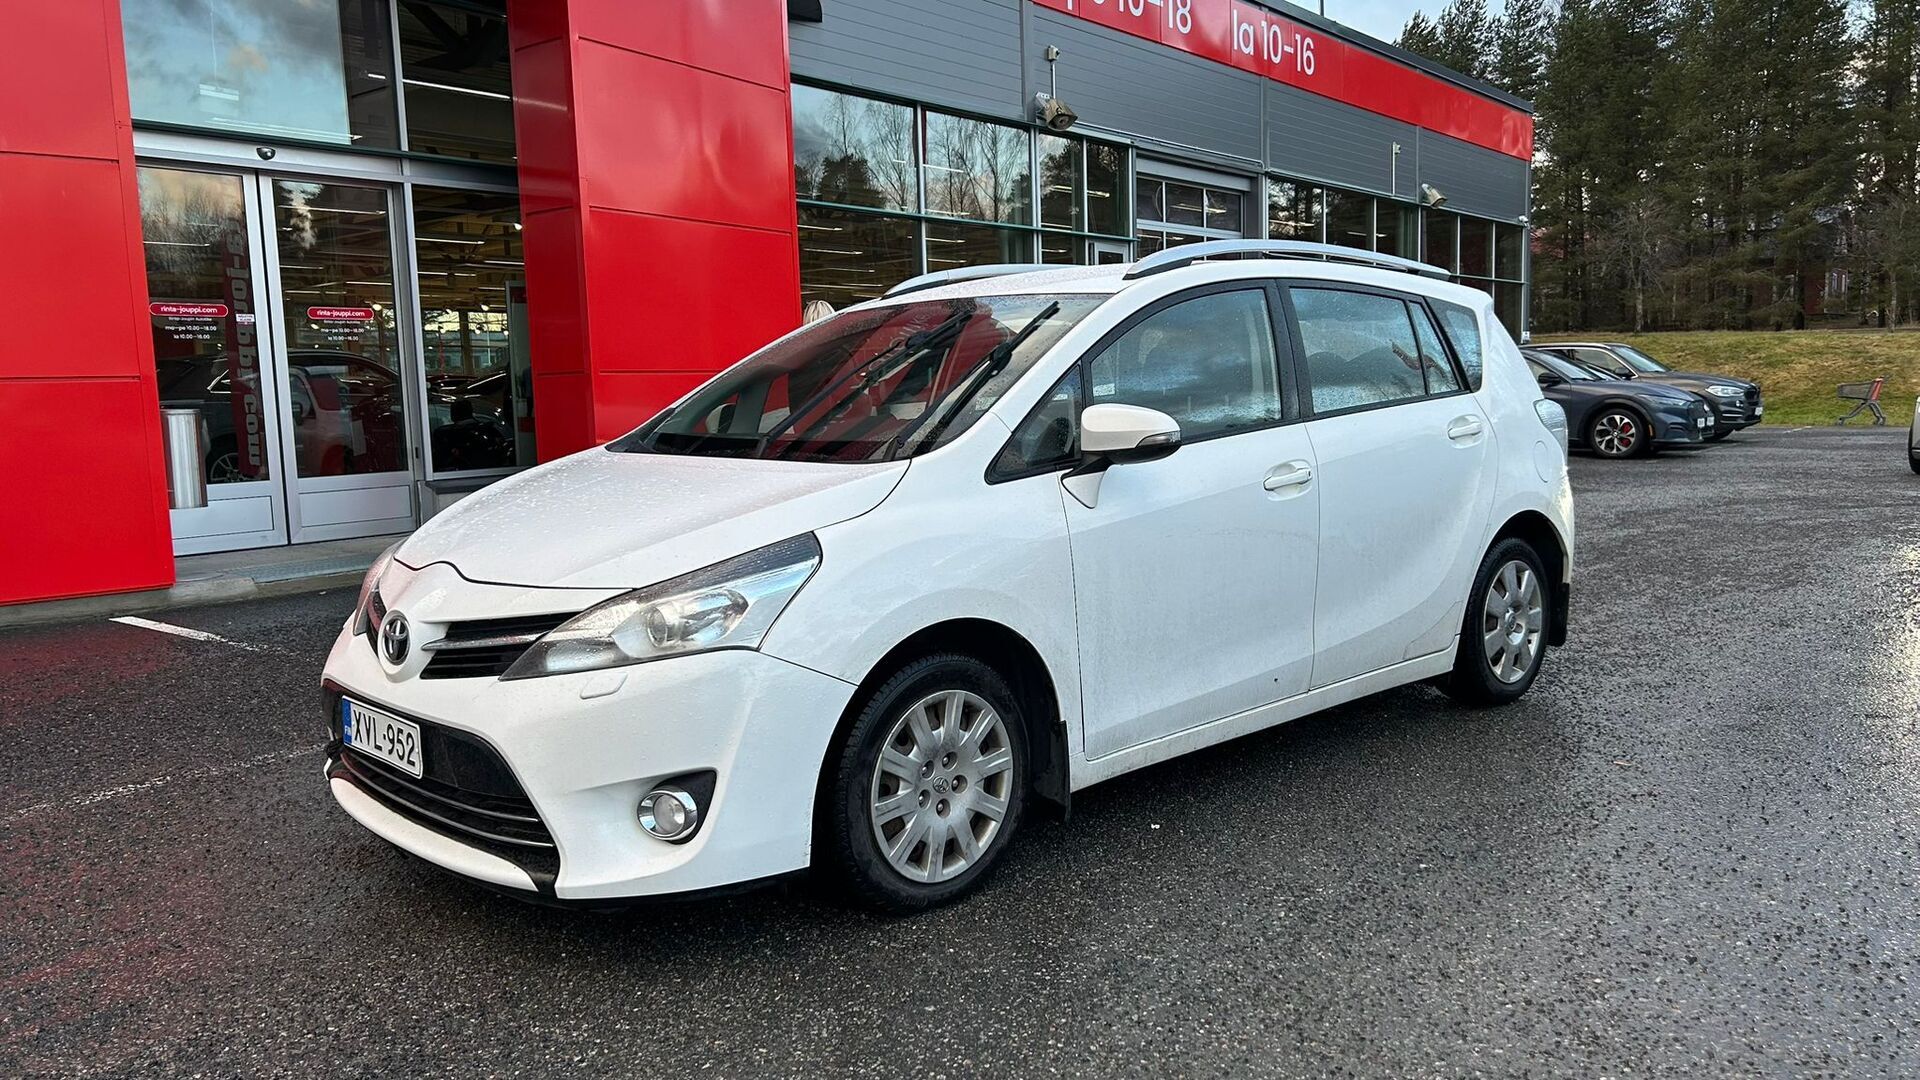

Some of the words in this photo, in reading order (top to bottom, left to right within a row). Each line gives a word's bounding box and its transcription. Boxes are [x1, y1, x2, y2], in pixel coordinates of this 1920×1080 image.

[1233, 9, 1254, 56] la
[1261, 20, 1315, 75] 10-16
[160, 305, 218, 314] rinta-jouppi.com
[316, 309, 366, 318] rinta-jouppi.com
[353, 709, 416, 767] XVL-952
